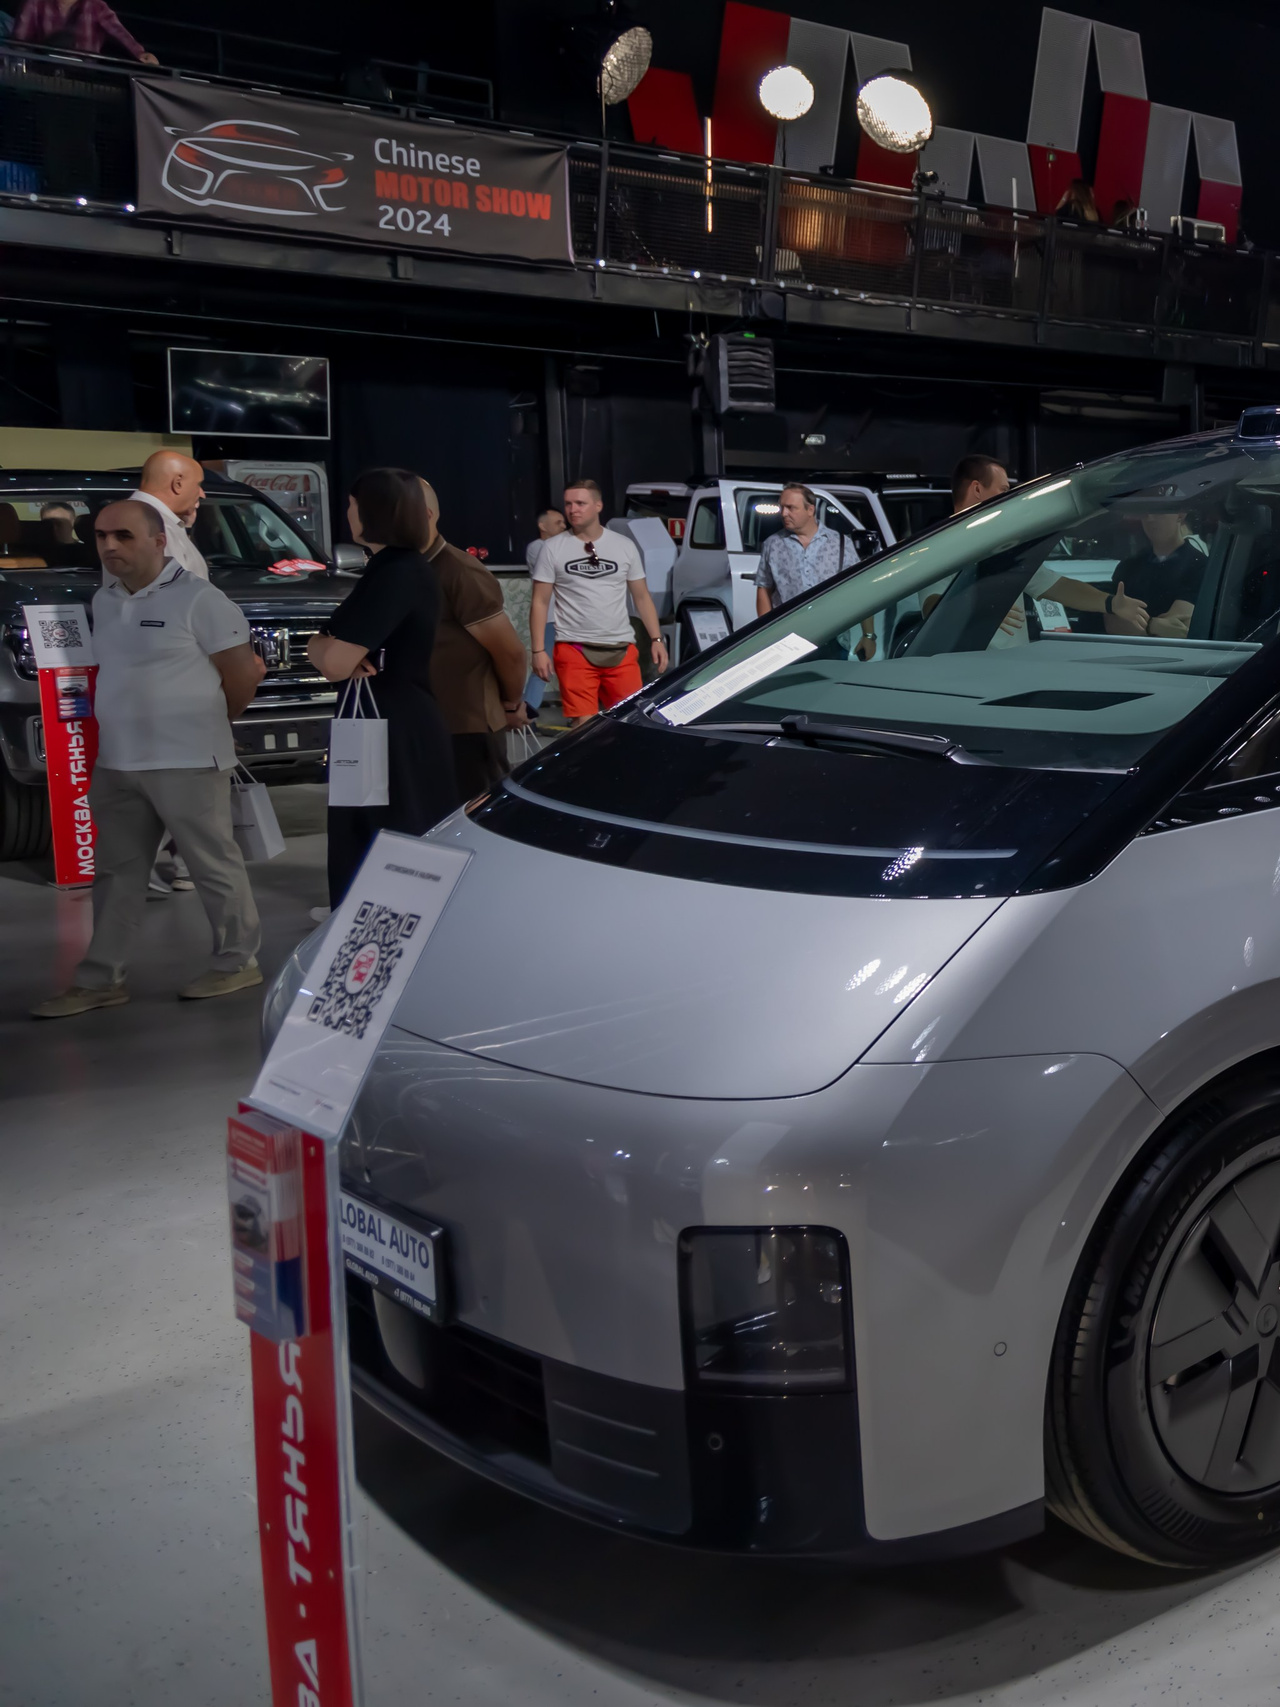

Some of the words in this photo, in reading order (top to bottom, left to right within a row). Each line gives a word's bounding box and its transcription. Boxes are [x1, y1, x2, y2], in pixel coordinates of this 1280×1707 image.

[374, 137, 481, 177] Chinese
[374, 169, 470, 210] MOTOR
[474, 184, 552, 221] SHOW
[378, 204, 452, 237] 2024
[73, 794, 96, 876] МОСКВА
[340, 1198, 386, 1246] LOBAL
[389, 1225, 430, 1270] AUTO
